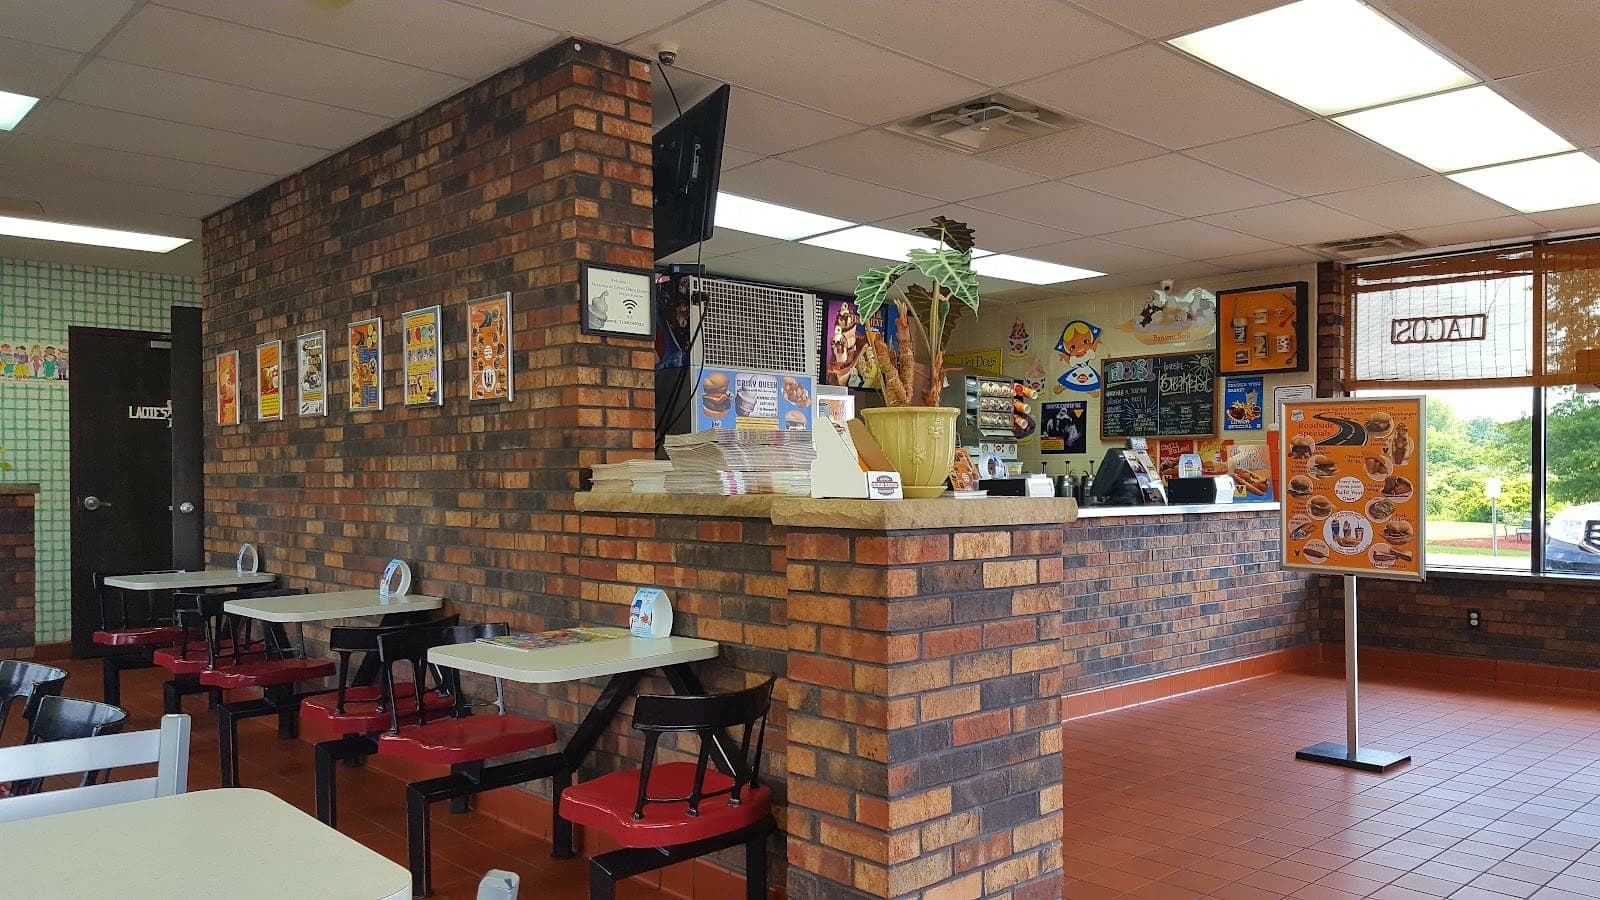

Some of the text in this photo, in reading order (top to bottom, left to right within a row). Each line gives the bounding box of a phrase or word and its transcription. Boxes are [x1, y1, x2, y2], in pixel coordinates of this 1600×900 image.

[128, 405, 169, 419] LADIES
[1298, 422, 1334, 430] Roadside
[1298, 430, 1331, 438] Specials
